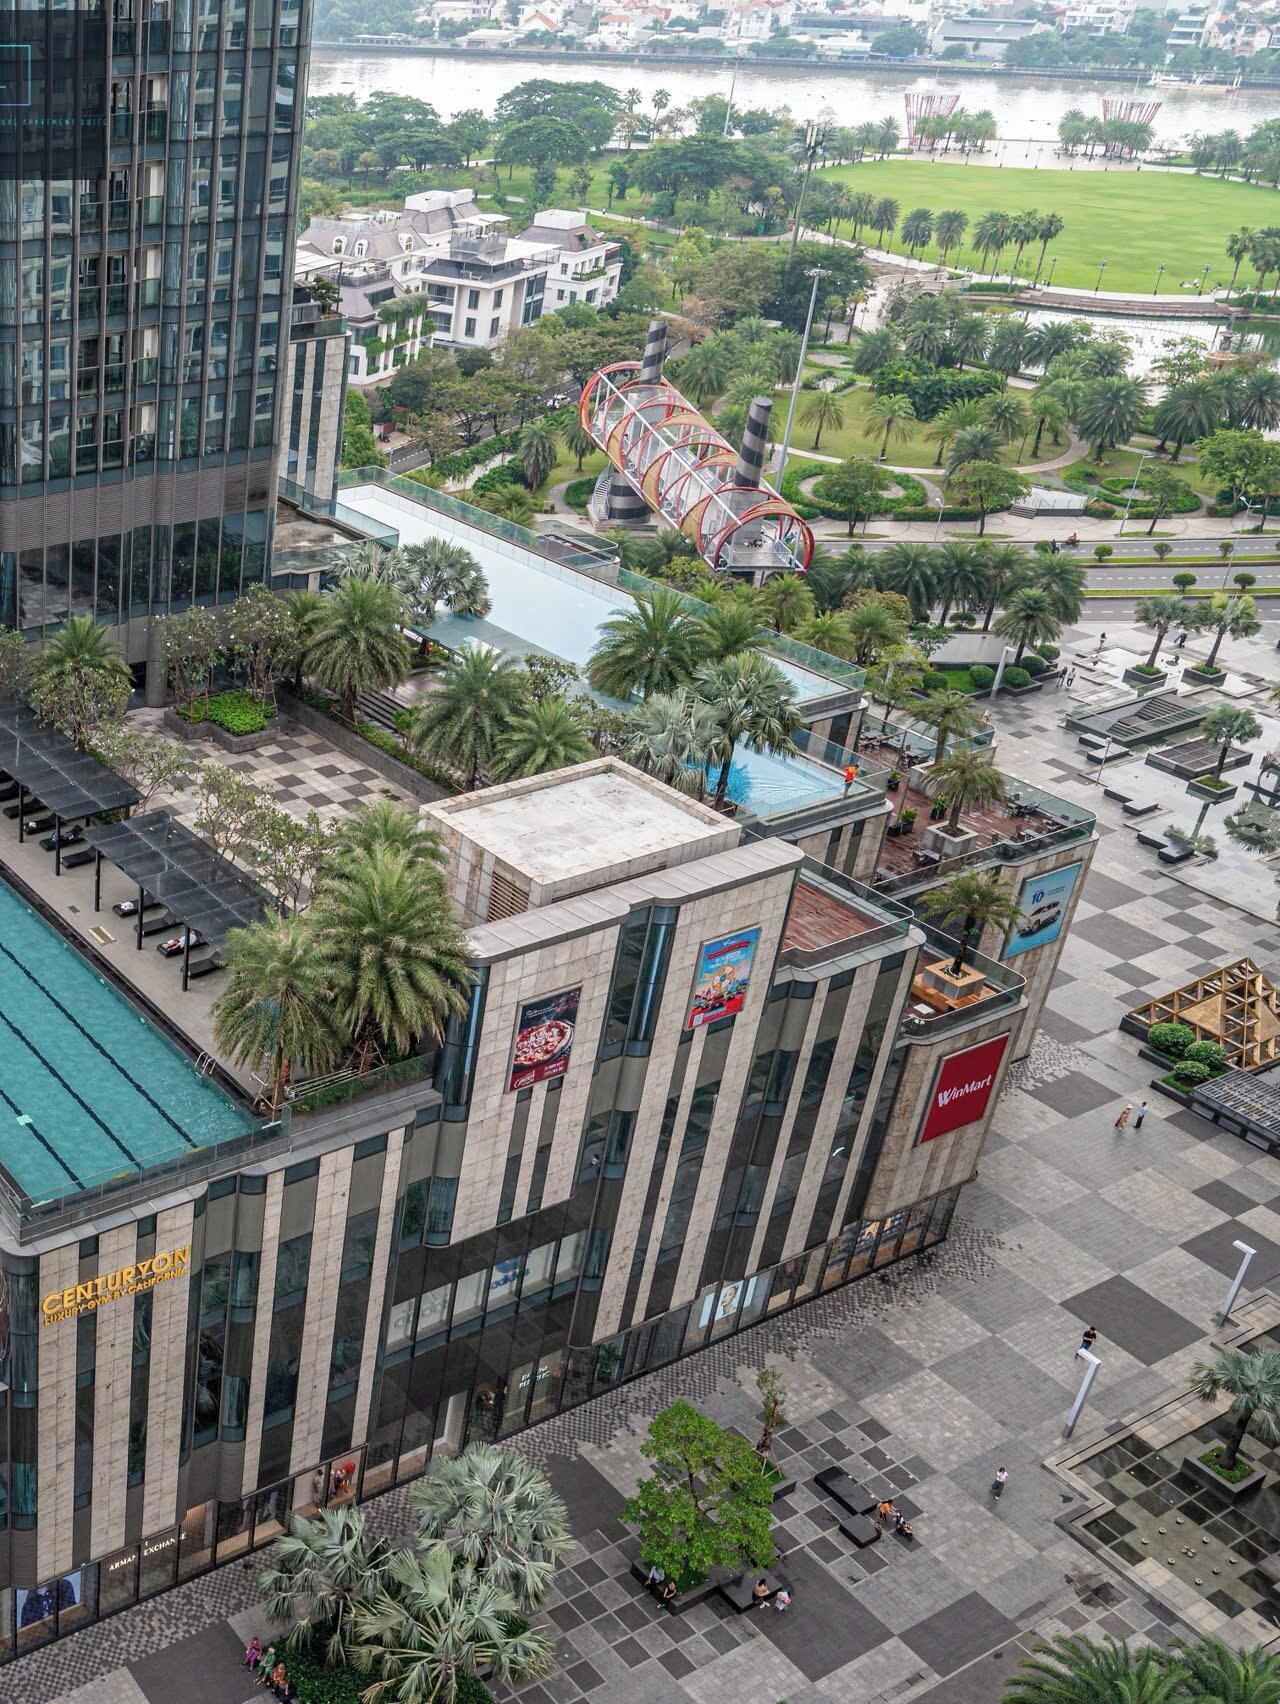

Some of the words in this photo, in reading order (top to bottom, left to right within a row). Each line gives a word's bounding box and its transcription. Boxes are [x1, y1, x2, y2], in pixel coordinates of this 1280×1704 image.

[937, 1074, 993, 1108] WinMart
[42, 1244, 190, 1314] CENTURYON
[43, 1303, 84, 1327] LUXURY
[87, 1295, 109, 1310] GYM
[113, 1288, 127, 1300] BY
[128, 1266, 187, 1294] CALIFORNIA
[108, 1553, 137, 1572] ARMAN
[143, 1532, 187, 1556] EXCHANE
